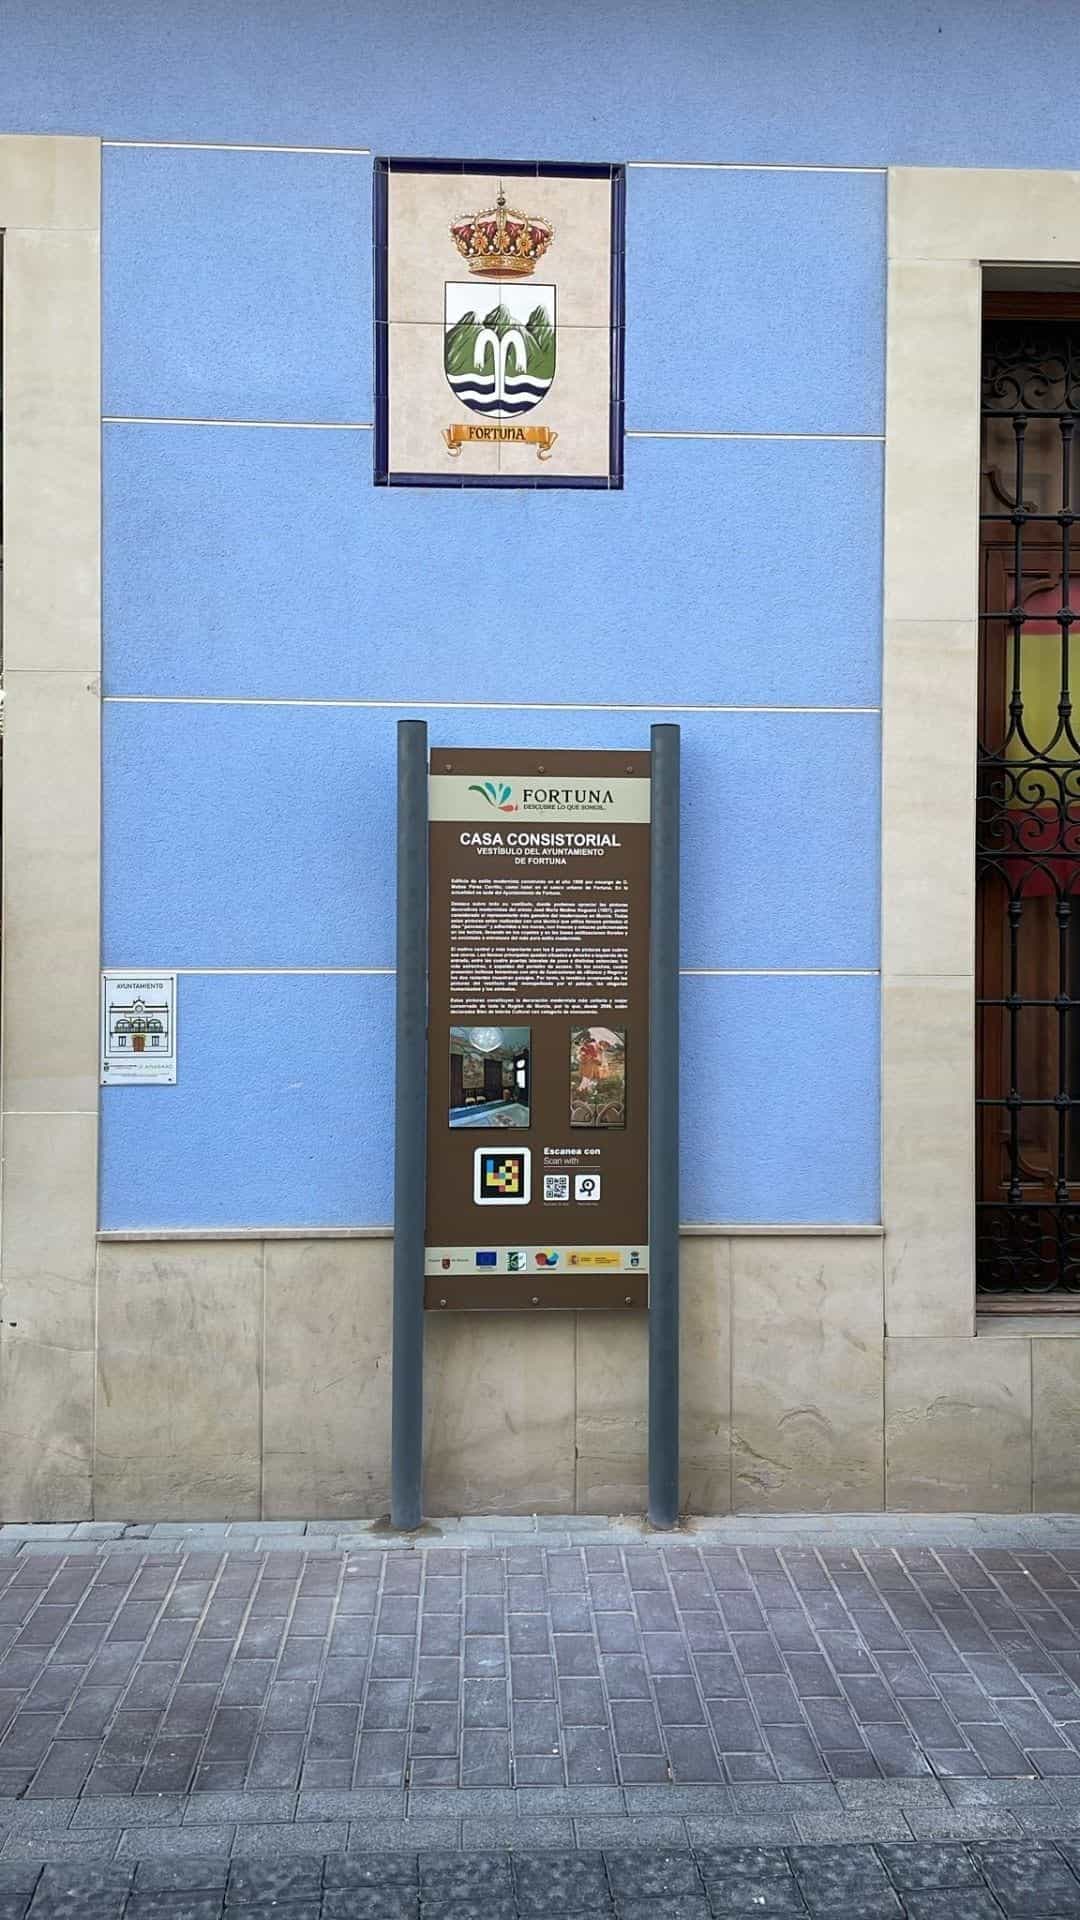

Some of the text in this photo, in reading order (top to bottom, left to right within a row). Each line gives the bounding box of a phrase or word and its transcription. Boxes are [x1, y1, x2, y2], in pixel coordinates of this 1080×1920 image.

[469, 427, 526, 440] FORTUNA
[523, 789, 614, 804] FORTUNA
[460, 833, 621, 847] CASA CONSISTORIAL
[476, 846, 604, 856] VESTÍBULO DEL AYUNTAMIENTO
[515, 857, 566, 865] DE FORTUNA
[543, 1147, 582, 1155] Escanea
[543, 1157, 579, 1165] Scan with
